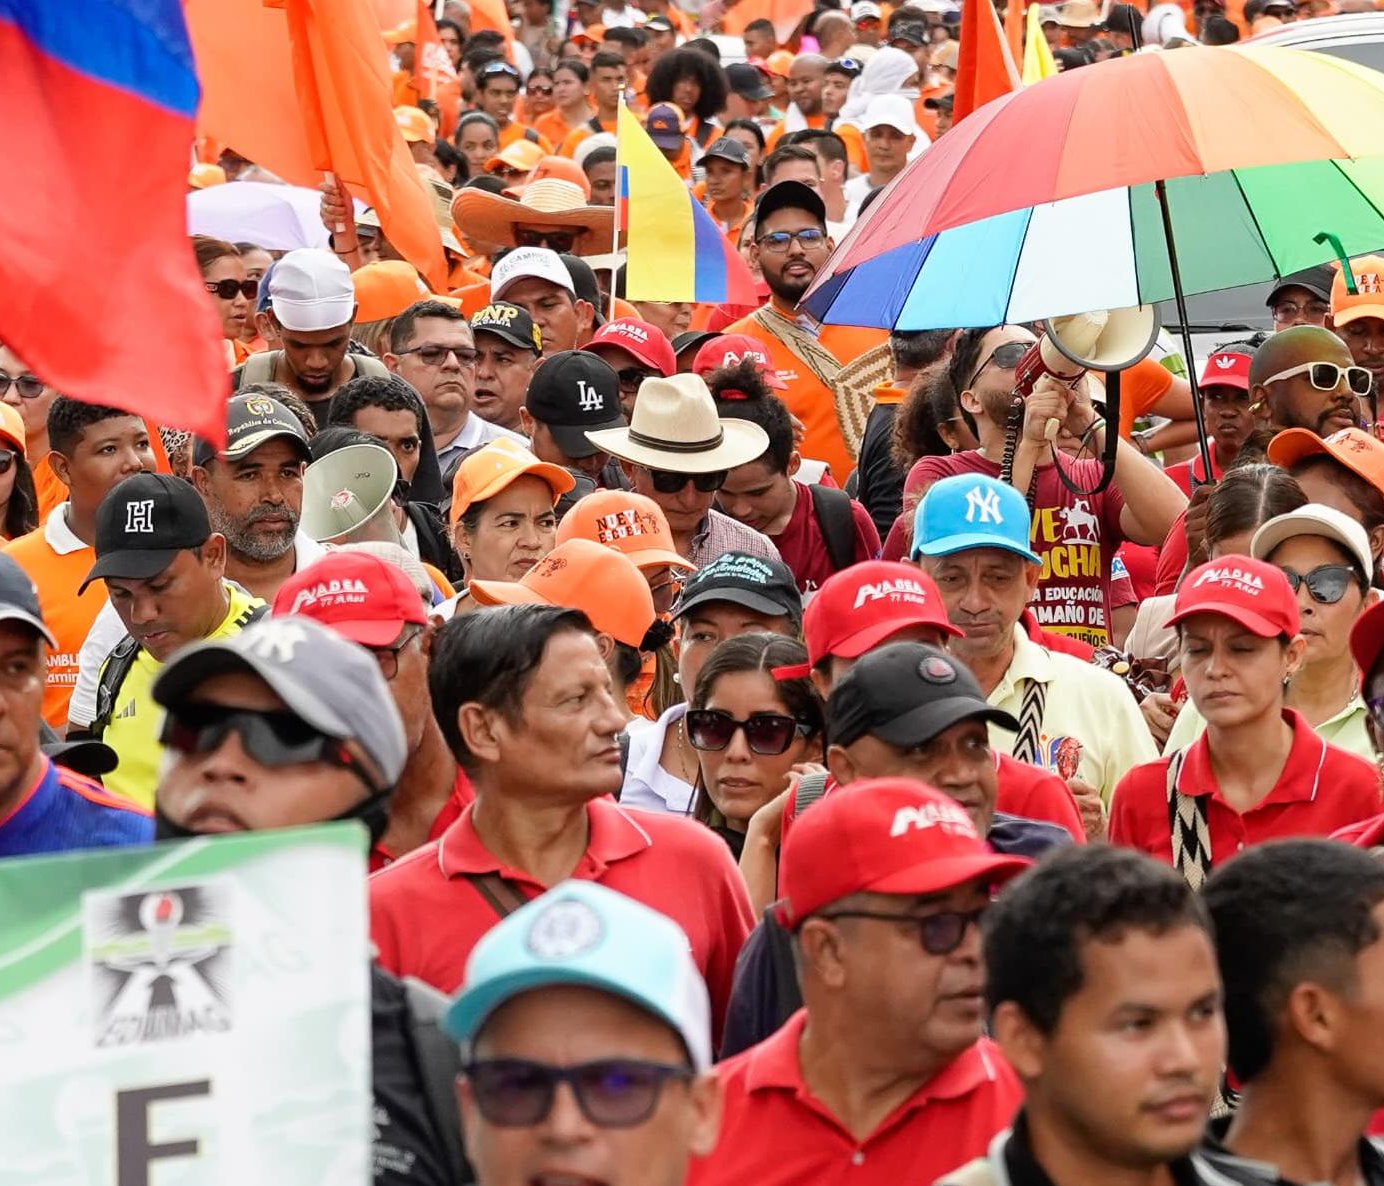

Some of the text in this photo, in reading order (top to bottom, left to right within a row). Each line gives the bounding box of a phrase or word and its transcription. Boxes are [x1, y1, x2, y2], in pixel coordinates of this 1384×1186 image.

[576, 380, 604, 411] LA
[124, 499, 155, 533] H
[965, 485, 1005, 526] NY
[595, 509, 640, 533] NUEVA
[598, 523, 649, 544] ESCUELA
[1038, 543, 1102, 580] UCHA
[1045, 584, 1104, 602] EDUCACIÓN
[1031, 600, 1106, 627] AMAÑO DE
